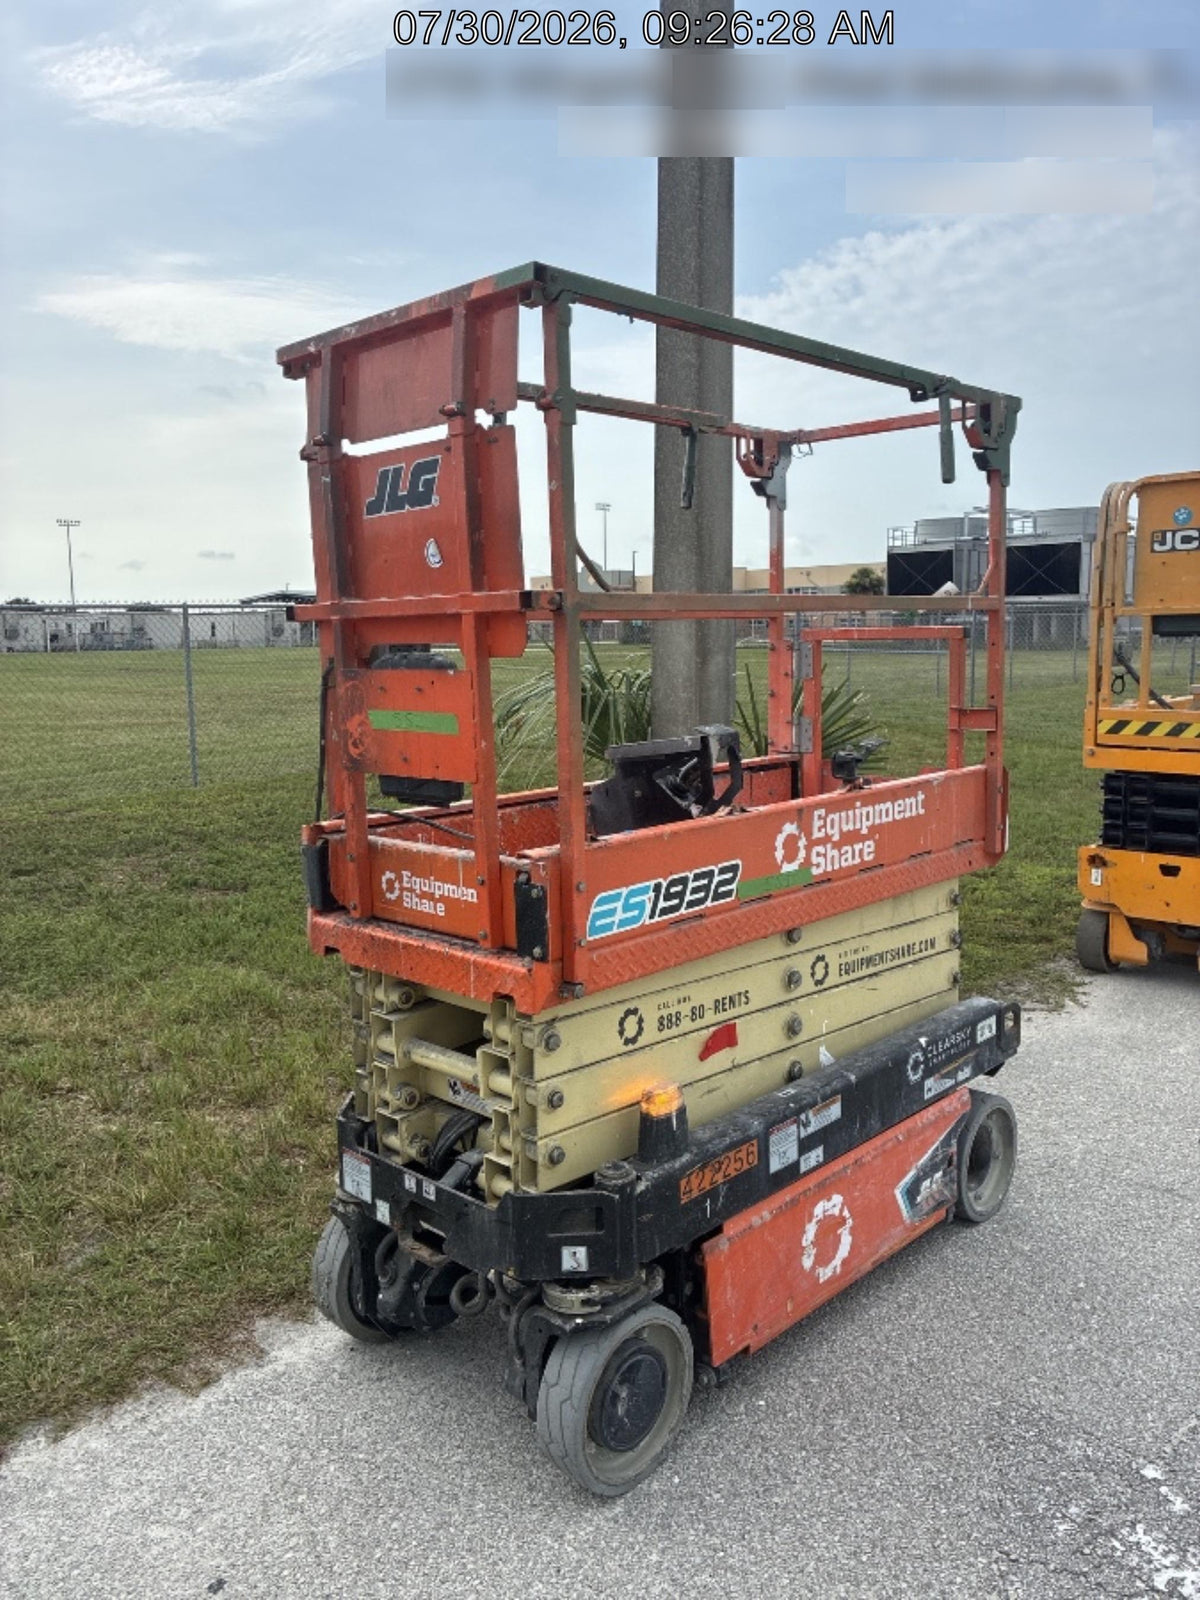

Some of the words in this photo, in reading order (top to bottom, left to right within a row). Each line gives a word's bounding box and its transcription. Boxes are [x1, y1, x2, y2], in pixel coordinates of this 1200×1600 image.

[363, 455, 441, 518] JLG
[1153, 529, 1200, 552] JC
[812, 790, 925, 841] Equipment
[811, 839, 877, 875] Share
[401, 870, 478, 903] Equipmen
[586, 858, 742, 940] ES1932
[838, 936, 937, 978] EQUIPMENTSHARE.COM
[657, 989, 750, 1033] 888-80-RENTS
